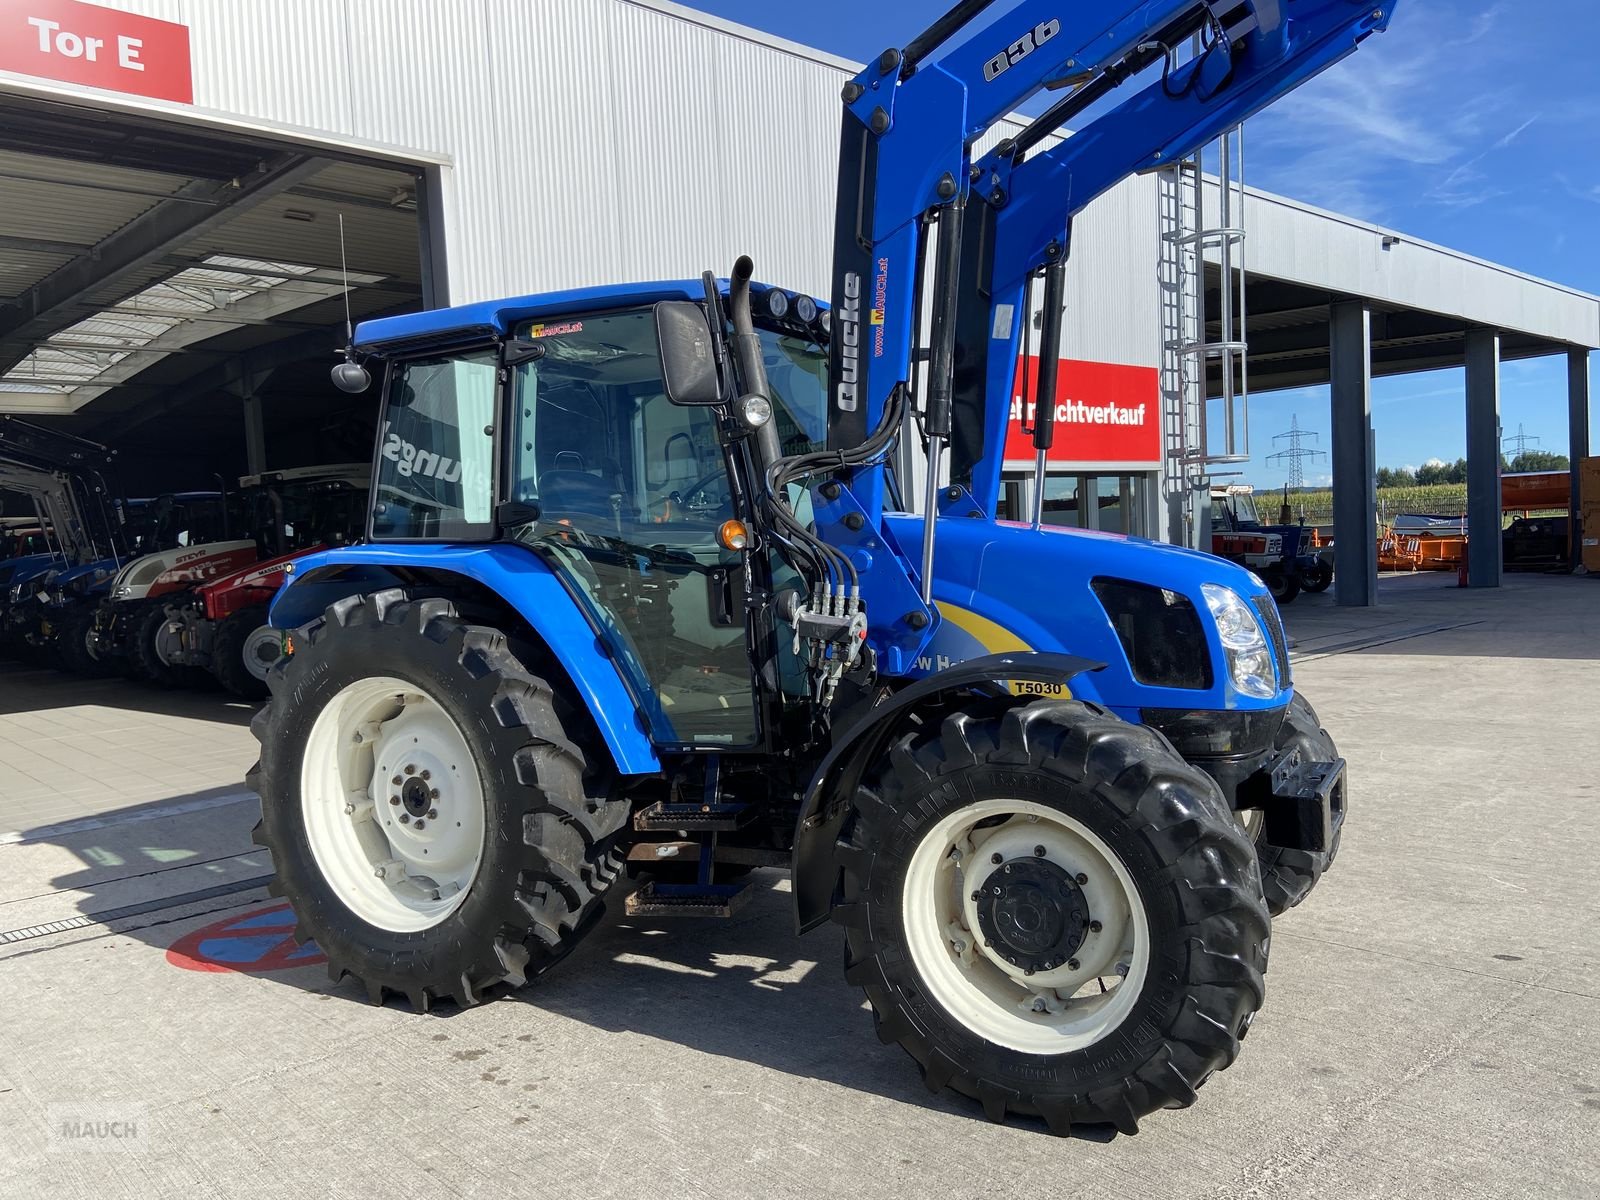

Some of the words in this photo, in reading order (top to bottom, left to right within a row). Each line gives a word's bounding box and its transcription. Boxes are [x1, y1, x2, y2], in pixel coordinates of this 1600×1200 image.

[28, 16, 103, 62] Tor
[117, 35, 145, 71] E
[983, 18, 1060, 83] Q36
[874, 258, 888, 358] www.MAUCH.at
[535, 321, 583, 337] MAUCH.at
[838, 272, 860, 412] Quicke
[1009, 396, 1145, 426] ebrchtverkauf
[176, 549, 206, 564] STEYR
[258, 564, 282, 576] MASSEY
[1015, 682, 1062, 695] T5030
